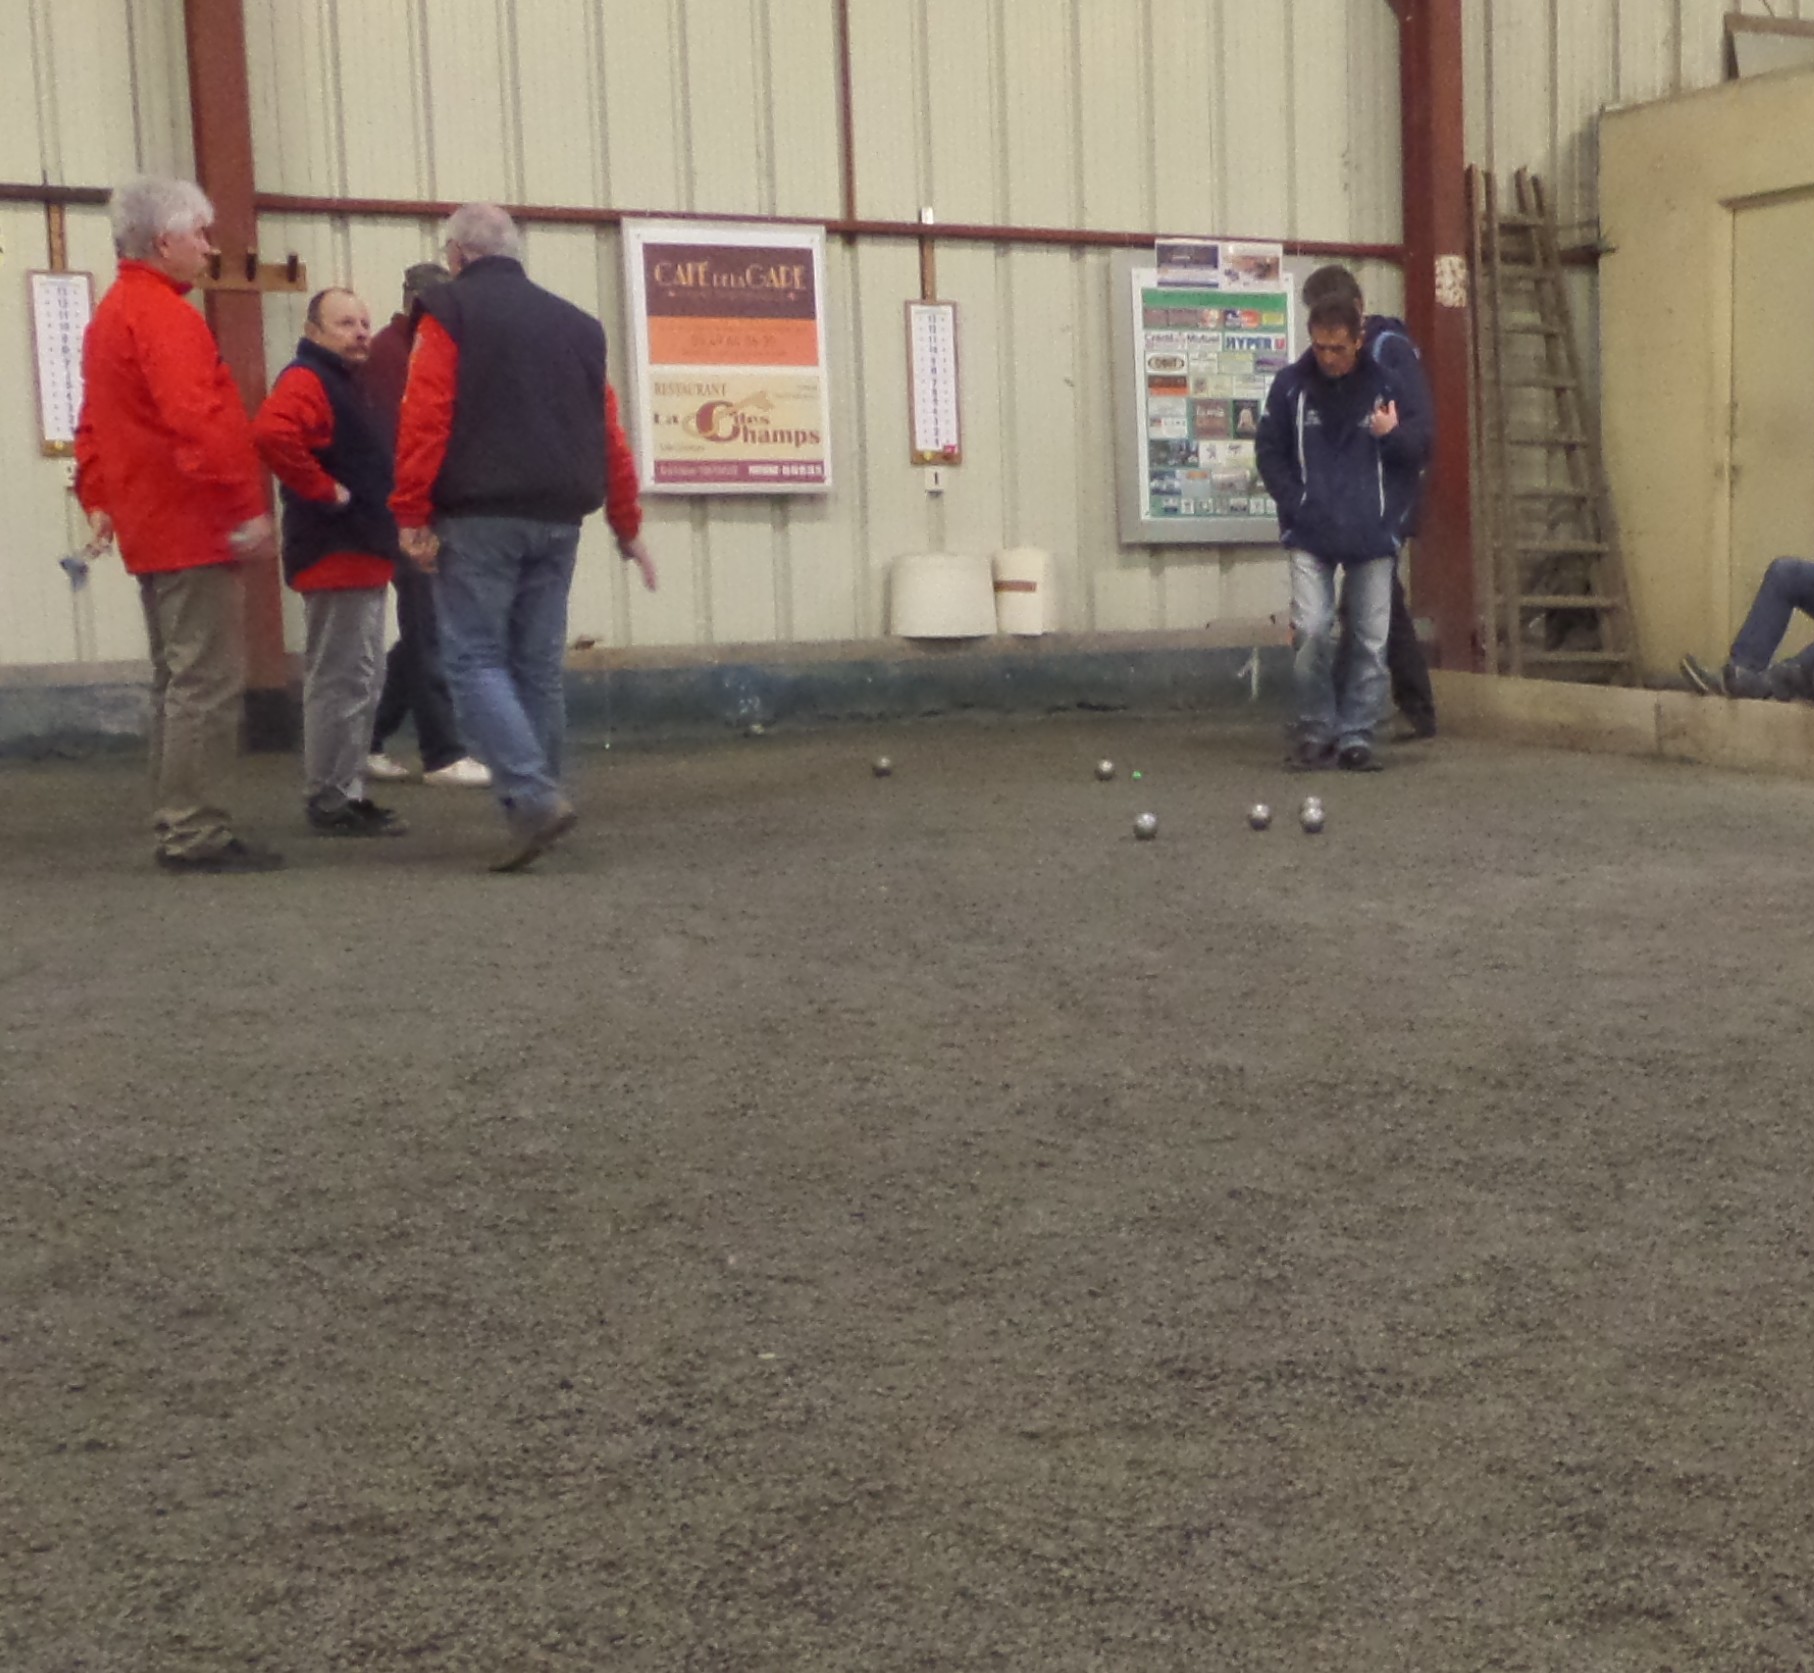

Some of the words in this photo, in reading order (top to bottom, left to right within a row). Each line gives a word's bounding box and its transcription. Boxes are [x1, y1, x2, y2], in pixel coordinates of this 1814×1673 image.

[1226, 336, 1272, 350] HYPER
[1274, 338, 1286, 350] U
[654, 382, 727, 397] RESTAURANT
[654, 413, 679, 425] La
